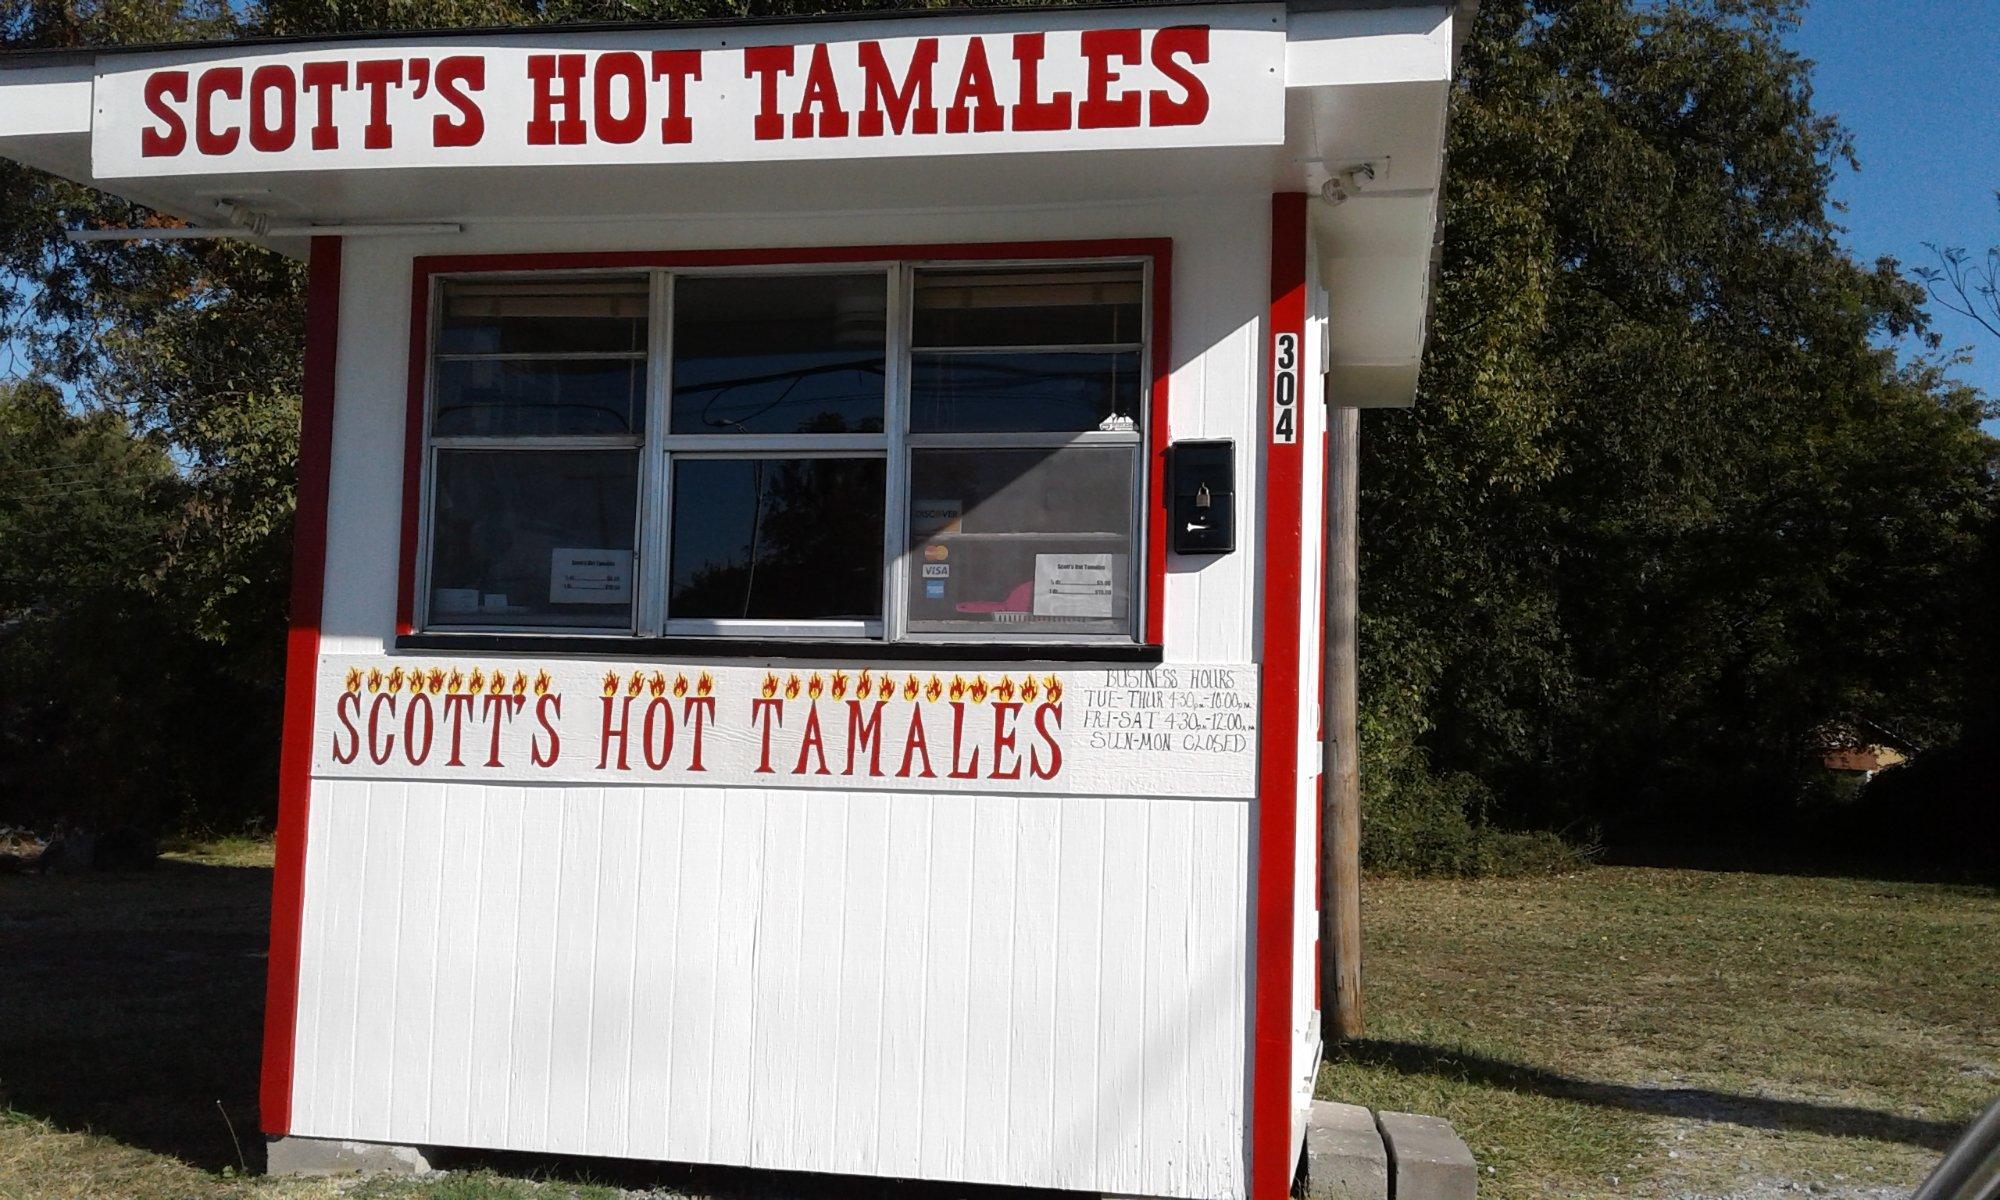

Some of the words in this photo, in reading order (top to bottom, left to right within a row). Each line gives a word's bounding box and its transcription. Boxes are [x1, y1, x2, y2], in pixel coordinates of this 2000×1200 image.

[142, 56, 485, 158] SCOTT'S
[527, 50, 702, 146] HOT
[744, 25, 1210, 141] TAMALES
[1276, 334, 1295, 442] 304
[926, 566, 948, 575] VISA
[1106, 668, 1178, 688] BUSINESS
[1190, 669, 1235, 688] HOURS
[332, 691, 562, 768] SCOTT'S
[595, 696, 717, 771] HOT
[752, 698, 1063, 781] TAMALES
[1183, 733, 1247, 752] CLOSED
